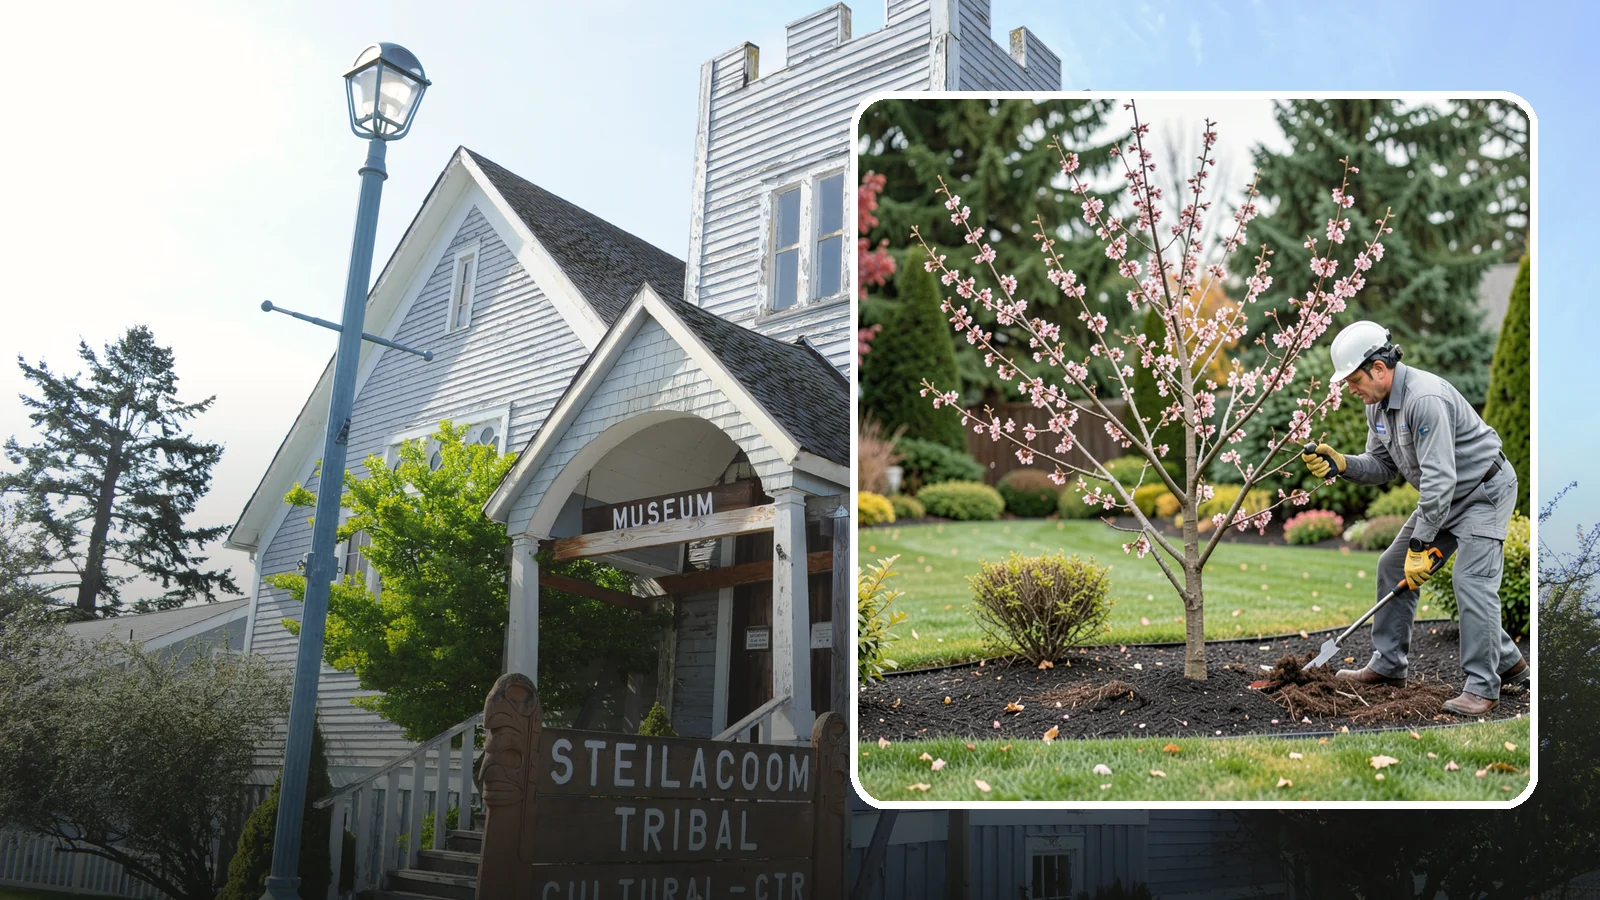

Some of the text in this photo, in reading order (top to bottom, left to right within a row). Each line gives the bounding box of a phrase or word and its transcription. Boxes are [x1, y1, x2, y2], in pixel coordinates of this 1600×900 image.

[613, 491, 714, 531] MUSEUM
[551, 738, 809, 793] STEILACOOM
[615, 806, 757, 851] TRIBAL
